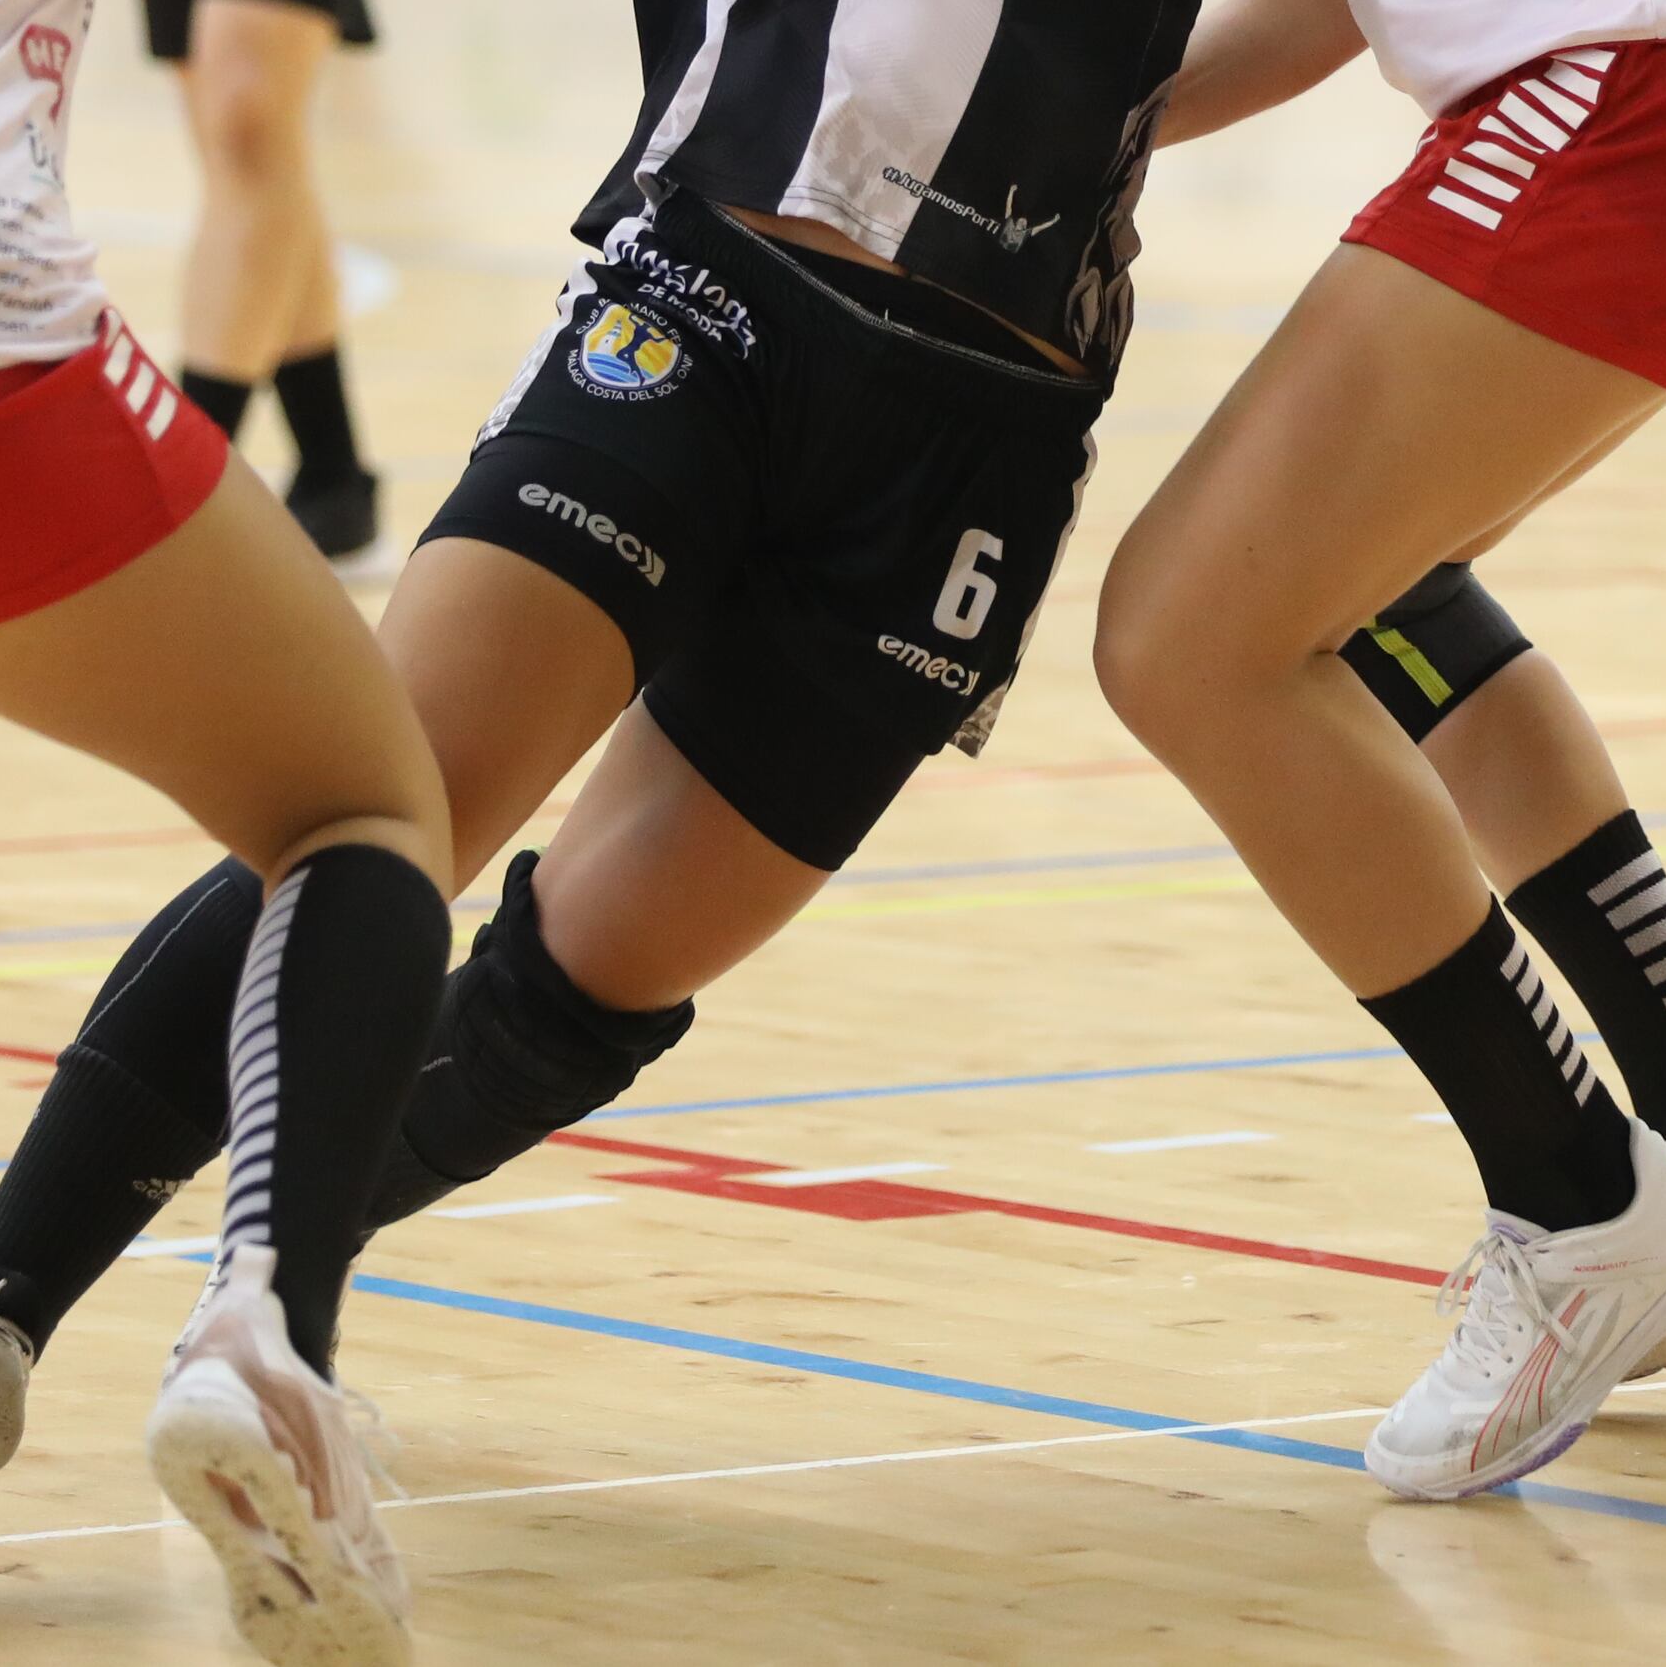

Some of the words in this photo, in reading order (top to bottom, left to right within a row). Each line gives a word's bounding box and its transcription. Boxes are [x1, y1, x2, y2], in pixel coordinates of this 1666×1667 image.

[882, 165, 1002, 235] #JugamosPorTi
[637, 283, 667, 299] DE
[586, 382, 626, 402] COSTA
[628, 390, 655, 402] DEL
[654, 380, 679, 399] SOL
[933, 527, 1004, 641] 6
